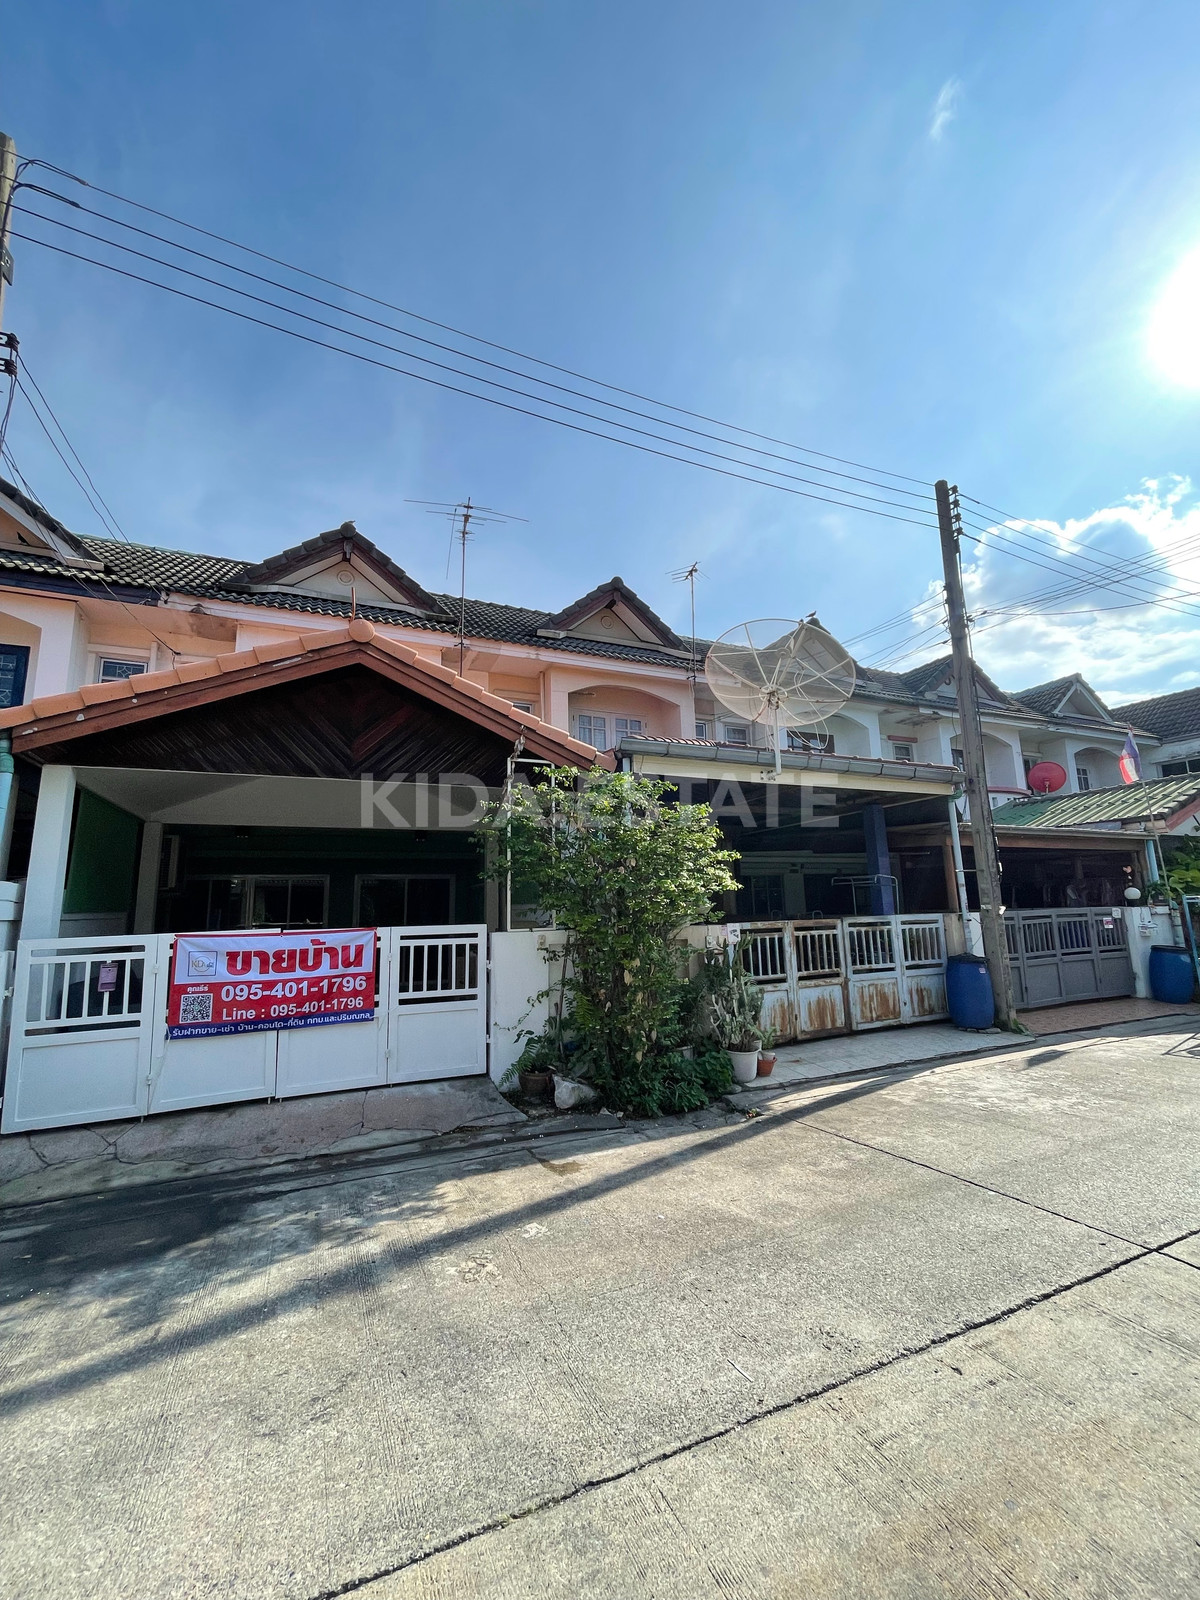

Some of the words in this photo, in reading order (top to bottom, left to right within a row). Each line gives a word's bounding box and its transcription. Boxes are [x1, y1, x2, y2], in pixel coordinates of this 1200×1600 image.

[225, 938, 364, 976] ขายบ้าน
[221, 975, 367, 1002] 095-401-1796
[222, 1007, 256, 1021] Line
[270, 996, 364, 1018] 095-401-1796
